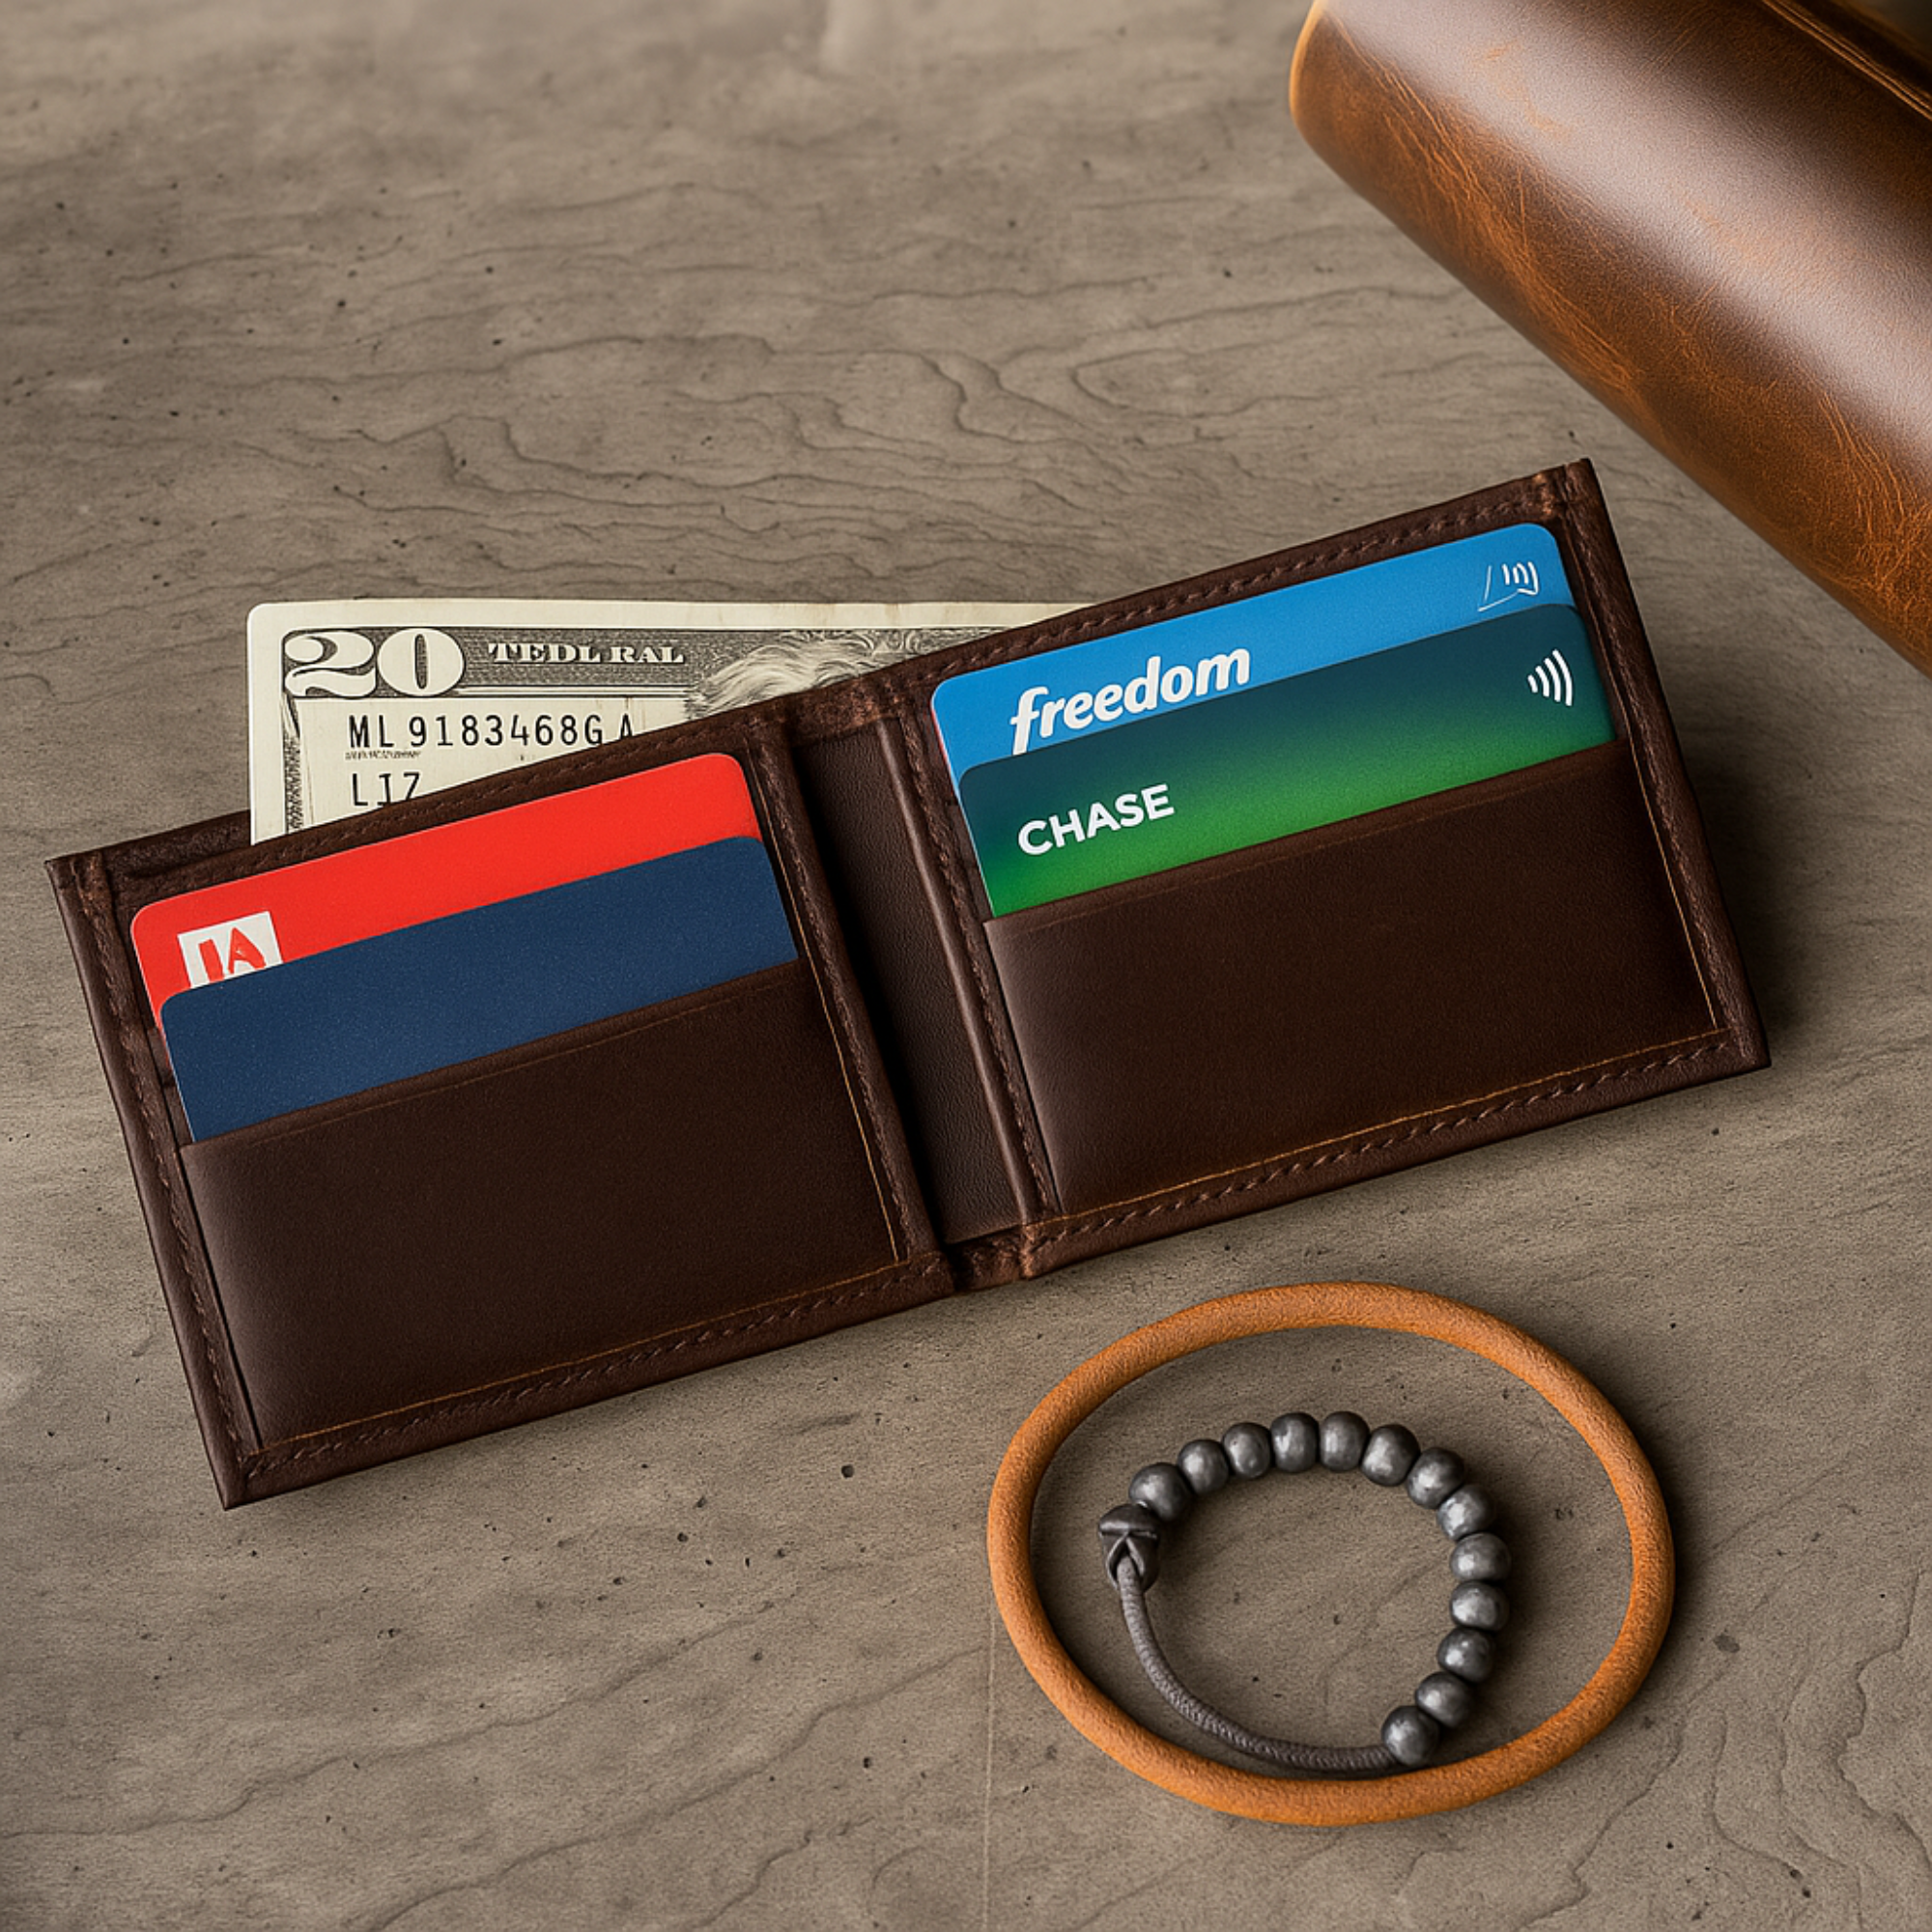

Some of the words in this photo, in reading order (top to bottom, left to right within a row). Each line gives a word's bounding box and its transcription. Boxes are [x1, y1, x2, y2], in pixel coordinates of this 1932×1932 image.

[284, 628, 465, 697] 20
[1010, 648, 1250, 755] freedom
[1018, 783, 1175, 855] CHASE
